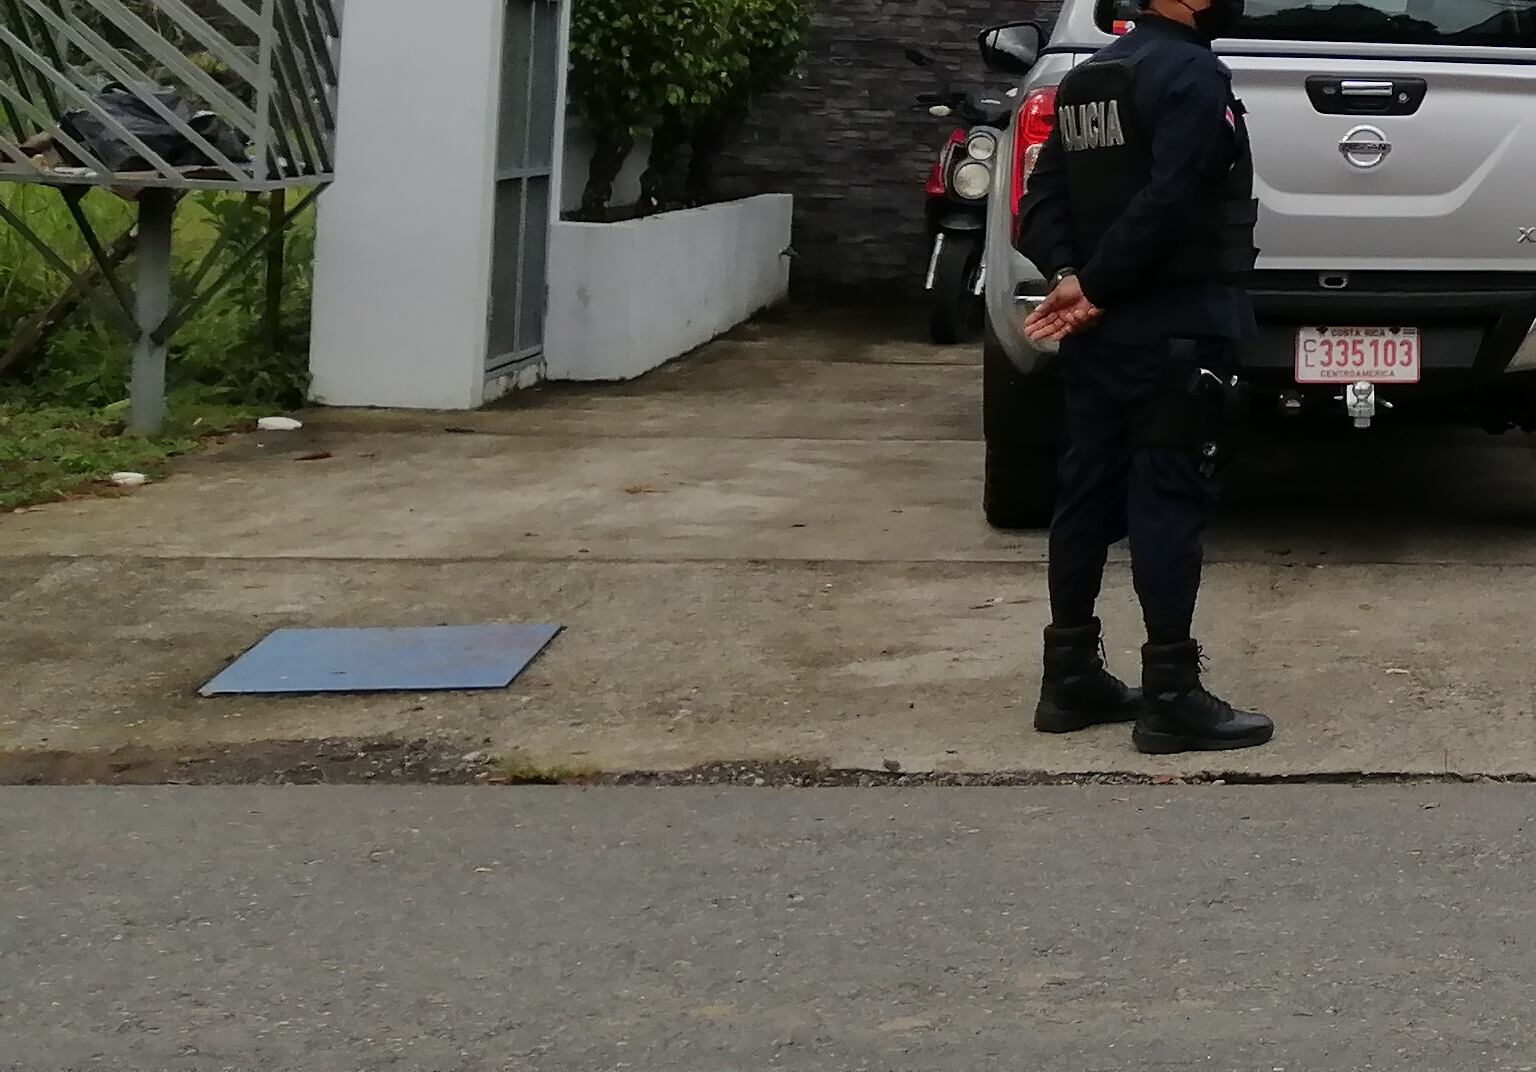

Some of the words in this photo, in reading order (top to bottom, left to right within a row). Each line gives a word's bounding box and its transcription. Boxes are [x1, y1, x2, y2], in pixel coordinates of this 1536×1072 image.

[1058, 99, 1125, 152] OLICIA
[1320, 339, 1414, 368] 335103
[1320, 369, 1396, 378] CENTROAMERICA
